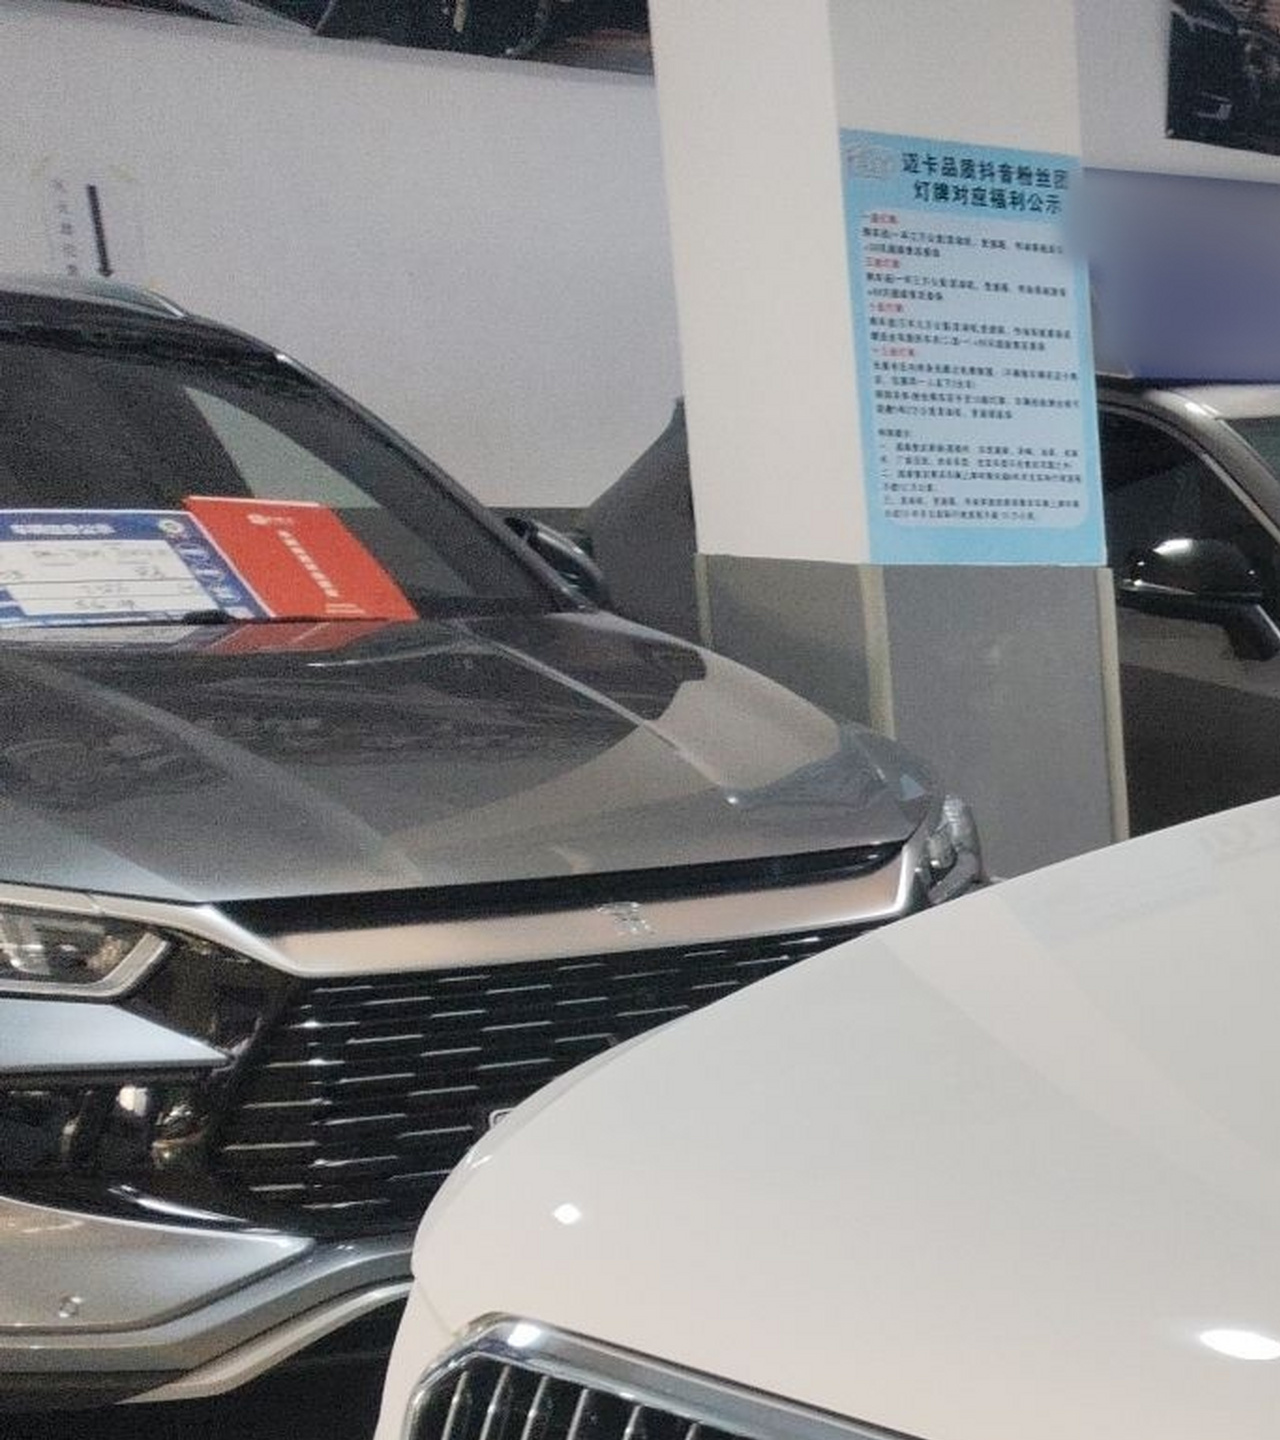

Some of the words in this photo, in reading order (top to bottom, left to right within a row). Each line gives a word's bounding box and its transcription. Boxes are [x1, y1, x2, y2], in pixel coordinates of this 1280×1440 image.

[913, 180, 1064, 215] 灯牌对应福利公示
